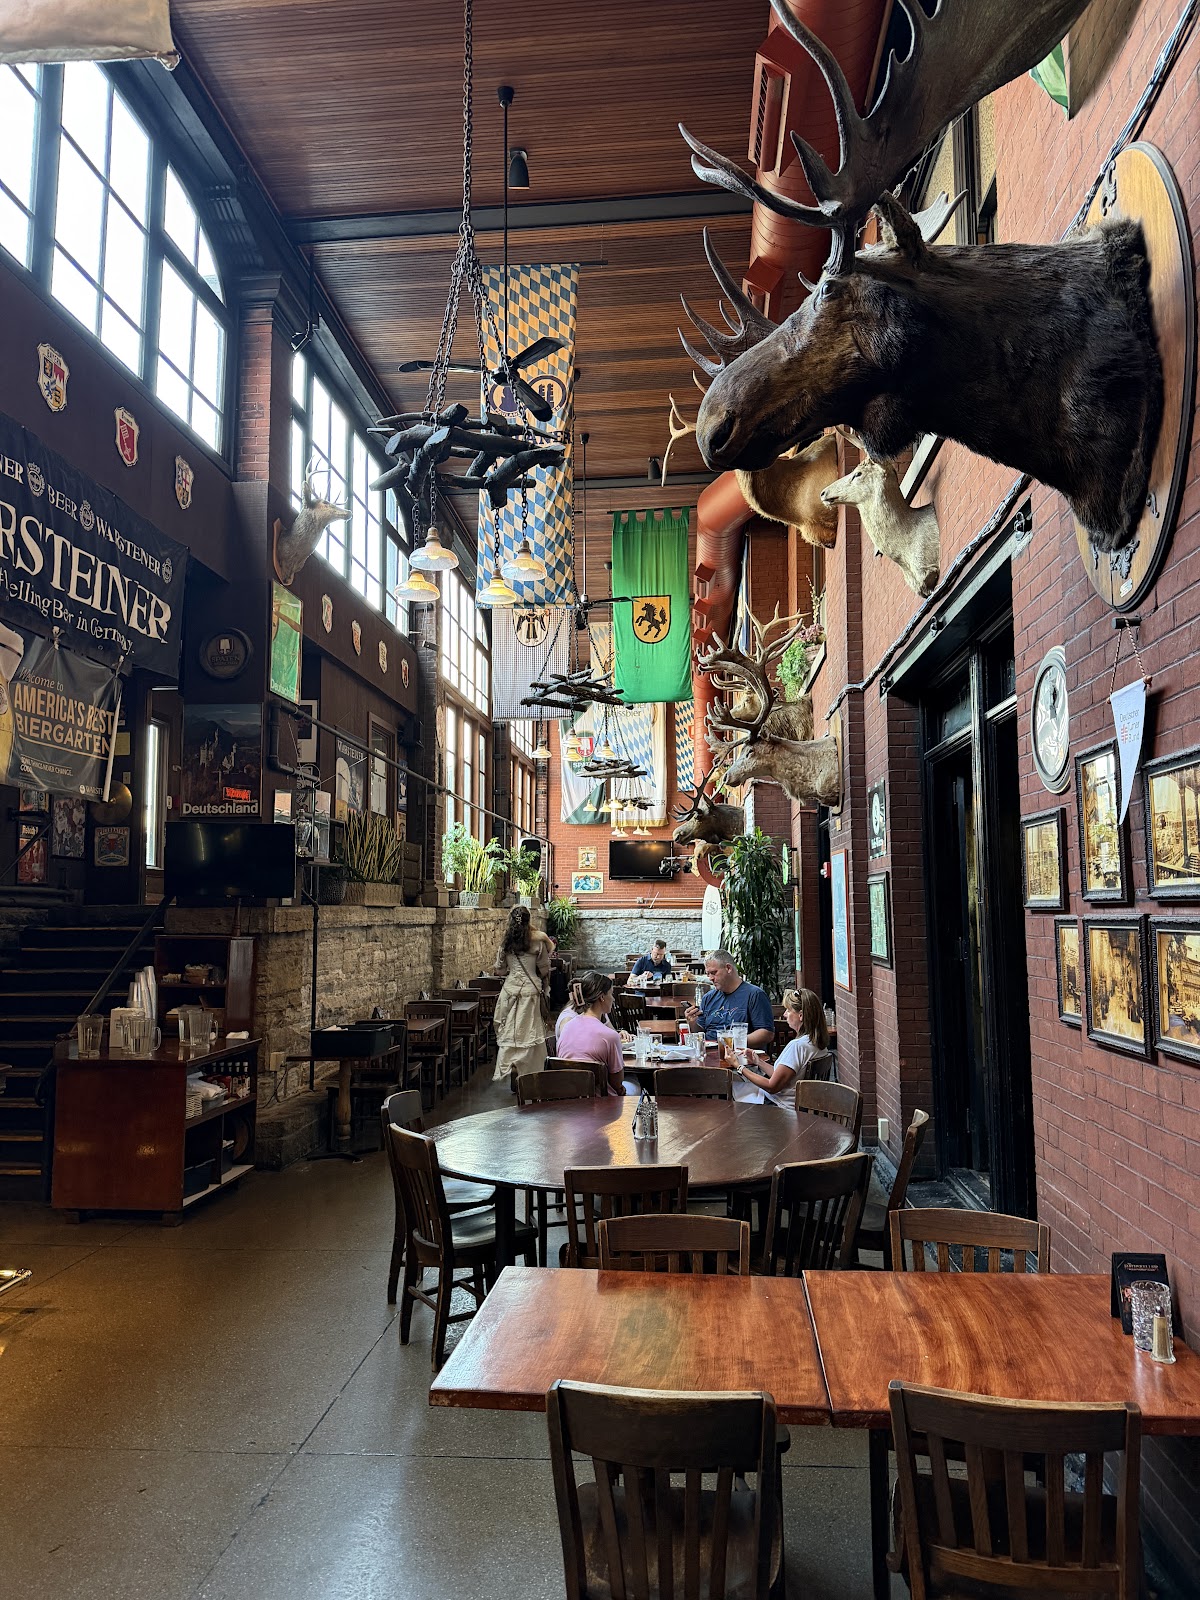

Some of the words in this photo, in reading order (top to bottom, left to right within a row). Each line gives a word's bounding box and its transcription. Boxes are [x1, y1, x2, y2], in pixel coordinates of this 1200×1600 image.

[47, 484, 78, 521] BEER
[76, 611, 88, 632] in
[57, 681, 64, 692] to
[14, 683, 85, 727] AMERICA'S
[87, 705, 117, 735] BEST
[15, 712, 113, 756] BIERGARTEN
[55, 766, 73, 776] CHANGE.
[182, 802, 259, 814] Deutschland
